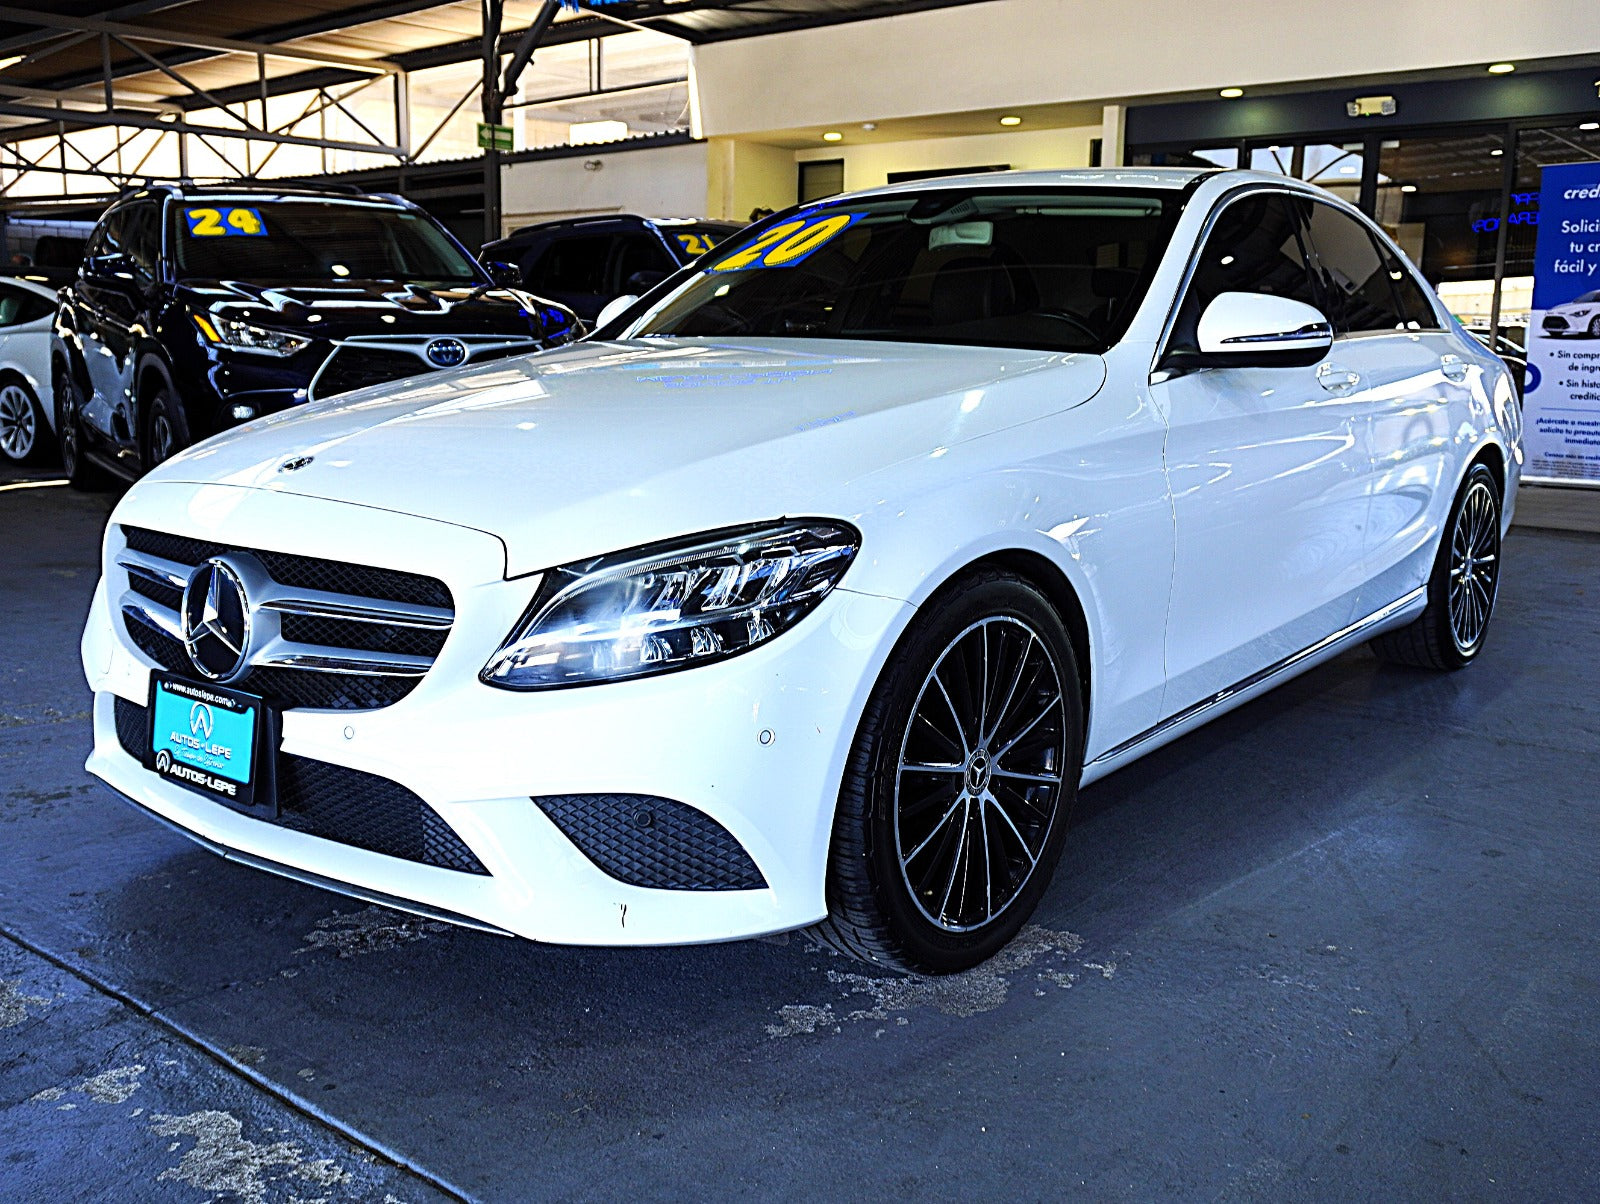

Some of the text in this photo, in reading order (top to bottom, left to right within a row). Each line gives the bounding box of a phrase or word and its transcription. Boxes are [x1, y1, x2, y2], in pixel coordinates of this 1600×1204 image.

[188, 207, 261, 236] 24
[677, 234, 716, 255] 21
[713, 214, 851, 271] 20
[1569, 241, 1584, 253] tu
[1554, 259, 1597, 276] fácil y
[1557, 350, 1571, 359] Sin
[1568, 362, 1579, 371] de
[1566, 379, 1579, 388] Sin
